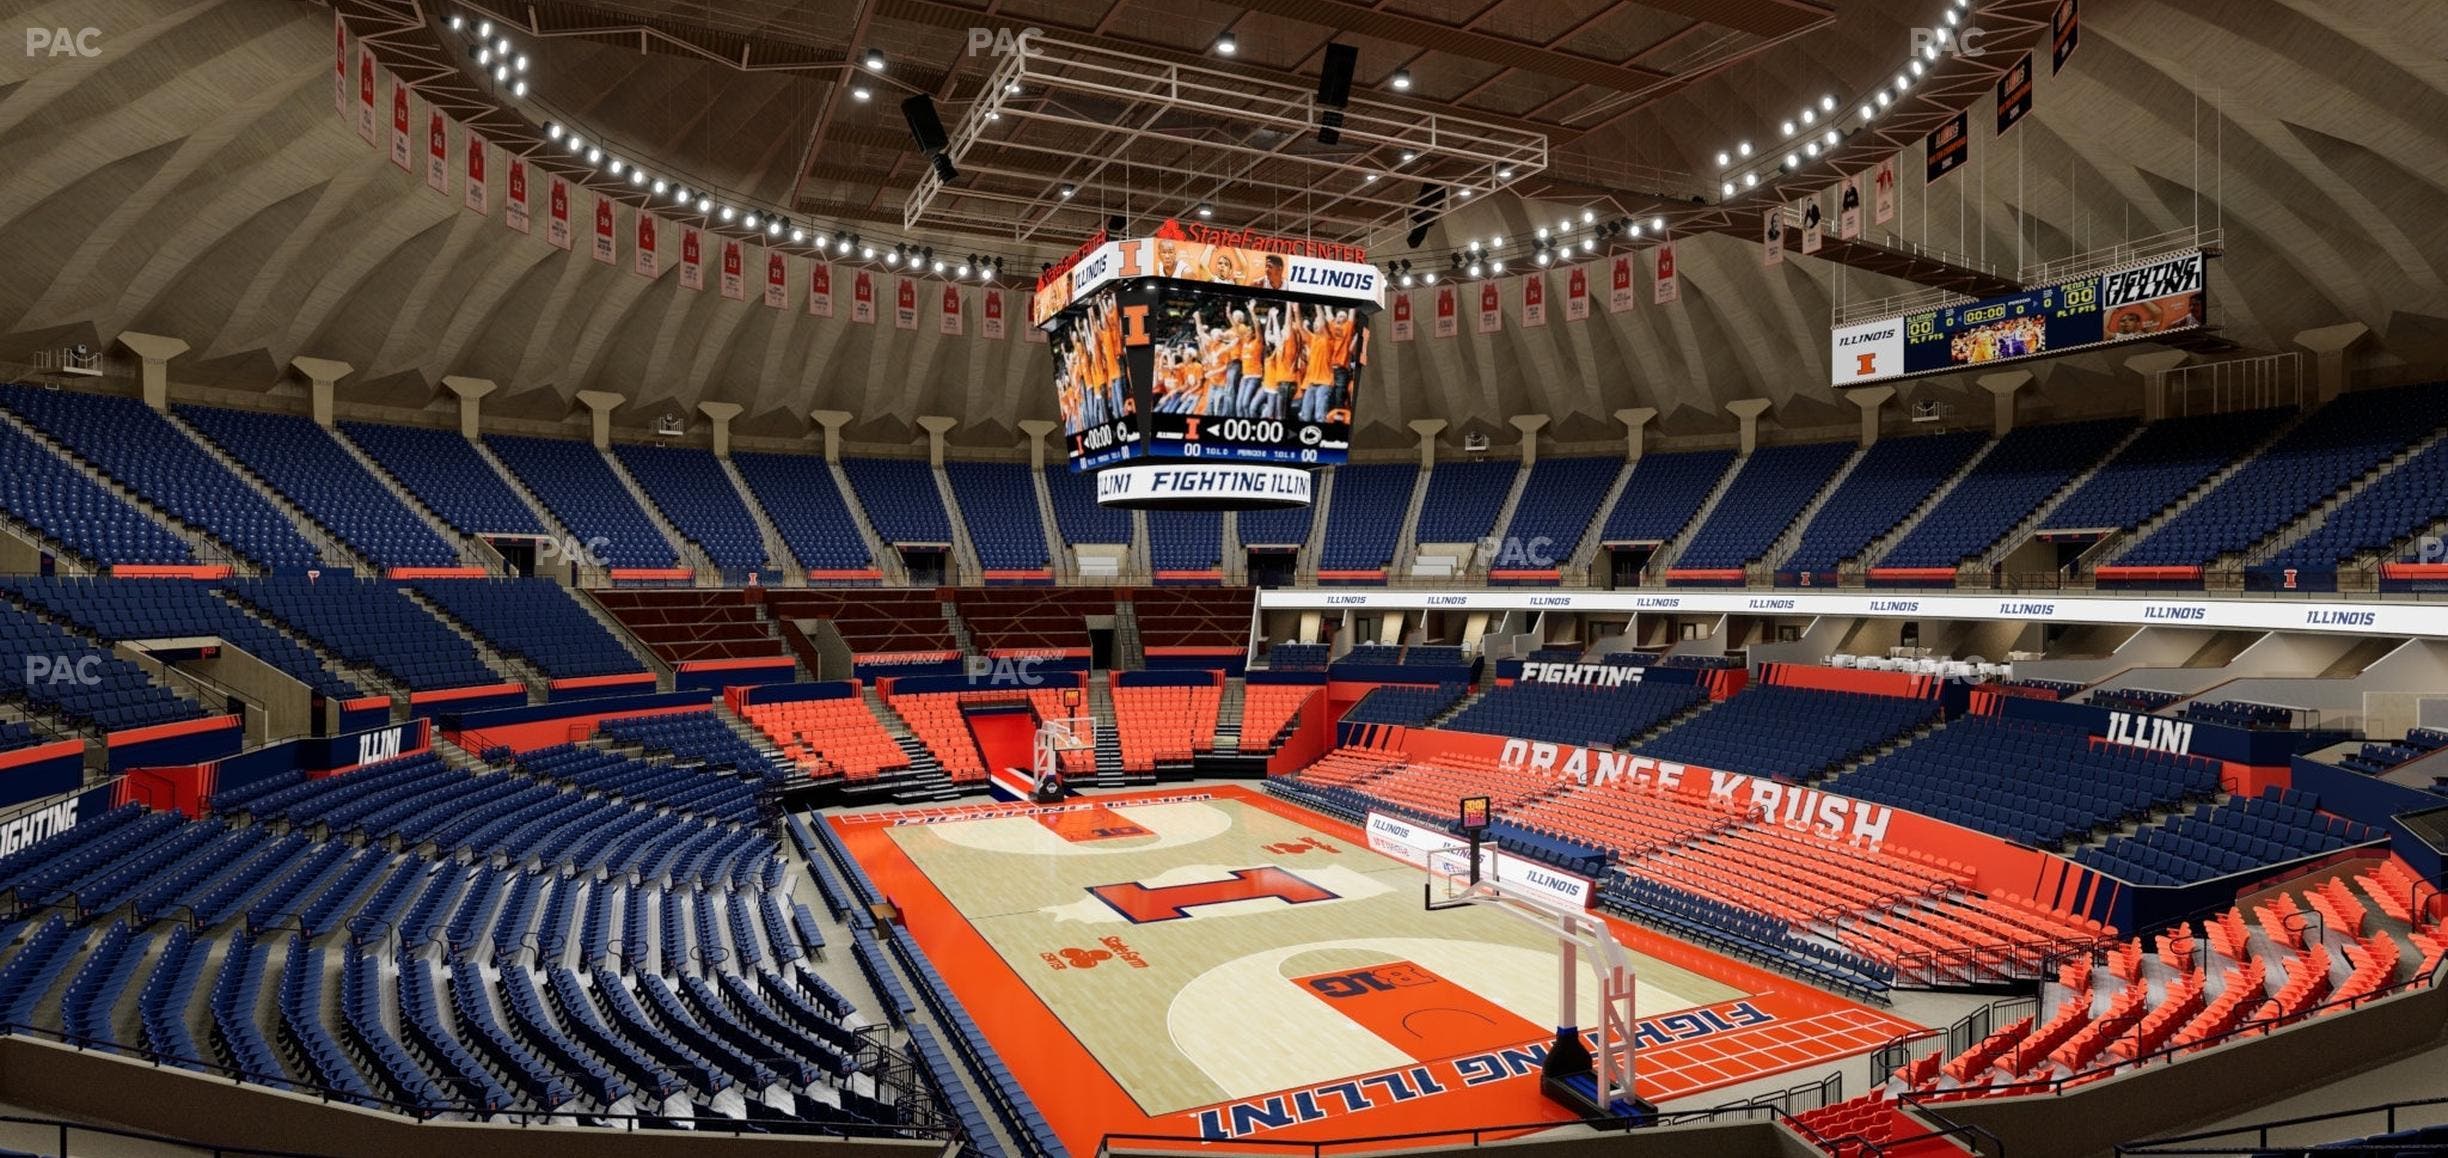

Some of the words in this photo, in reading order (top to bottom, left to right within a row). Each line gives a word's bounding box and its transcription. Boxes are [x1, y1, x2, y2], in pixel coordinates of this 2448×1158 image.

[1074, 253, 1108, 289] ILLINOIS
[1290, 265, 1373, 291] ILLINOIS
[2067, 288, 2094, 305] 00
[1966, 306, 2005, 322] 00:00
[1909, 321, 1932, 336] 00
[1839, 328, 1896, 347] ILLINOIS
[1223, 418, 1284, 443] 00:00
[1184, 442, 1201, 457] 00
[1301, 449, 1318, 463] 00
[1151, 471, 1267, 492] FIGHTING
[1326, 595, 1367, 604] ILLINOIS
[1427, 596, 1468, 605] ILLINOIS
[1529, 597, 1572, 606] ILLINOIS
[1636, 597, 1680, 607] ILLINOIS
[1749, 599, 1795, 609] ILLINOIS
[1869, 601, 1919, 612] ILLINOIS
[1999, 603, 2055, 615] ILLINOIS
[2144, 606, 2207, 620] ILLINOIS
[2306, 610, 2376, 626] ILLINOIS
[1521, 662, 1646, 687] FIGHTING
[2106, 712, 2193, 756] ILLINI
[358, 727, 402, 766] ILLINI
[1499, 738, 1686, 796] ORANGE
[1705, 770, 1893, 853] KRUSH
[1373, 818, 1411, 838] ILLINOIS
[1526, 869, 1580, 896] ILLINOIS
[1199, 1066, 1446, 1143] ILLINI
